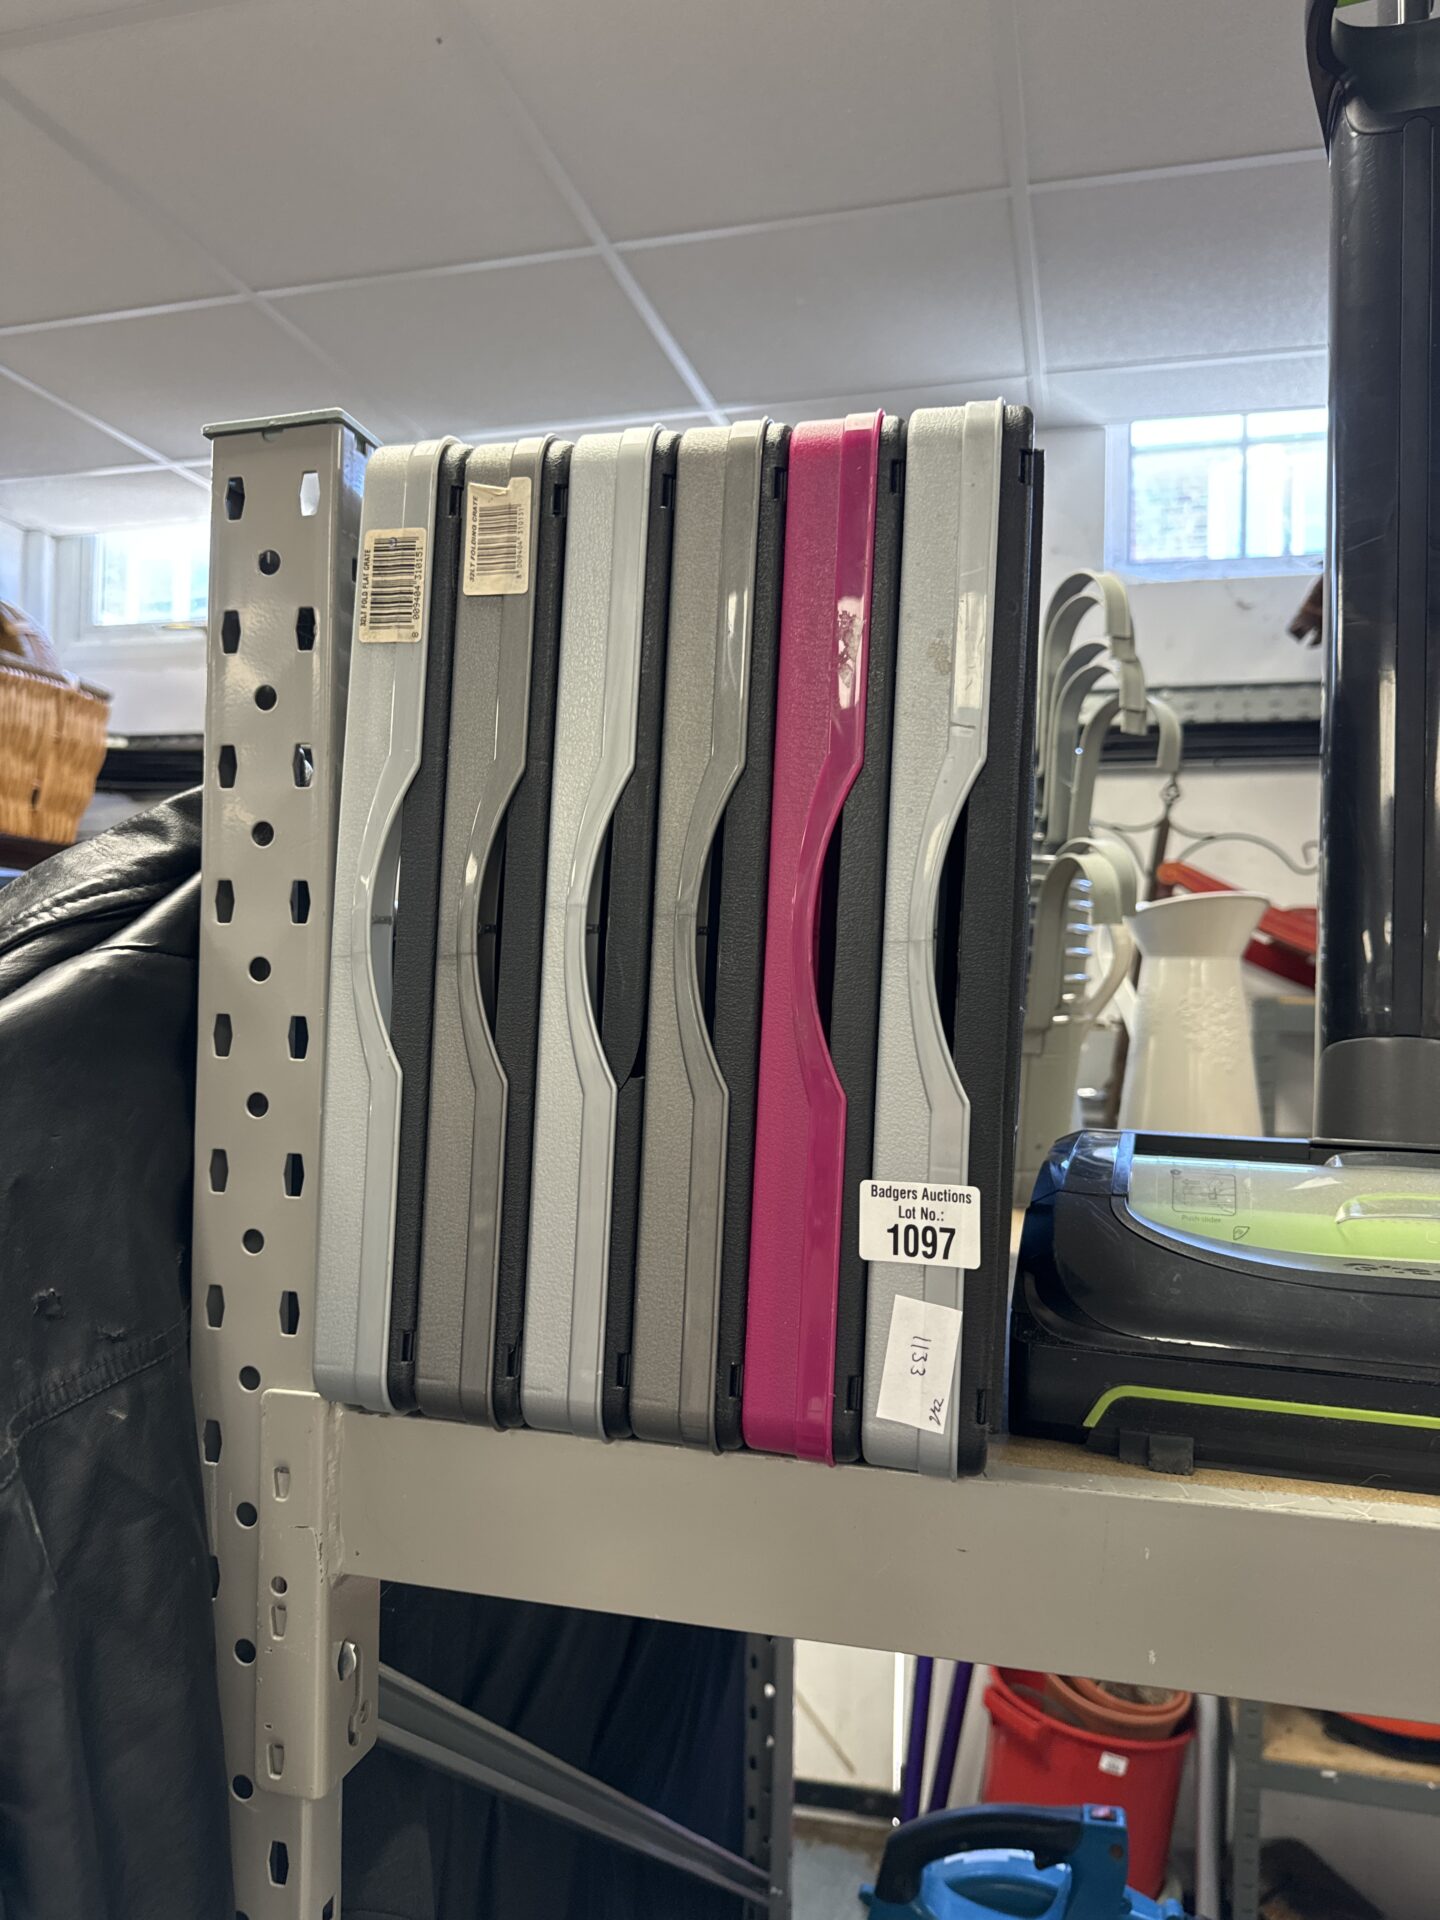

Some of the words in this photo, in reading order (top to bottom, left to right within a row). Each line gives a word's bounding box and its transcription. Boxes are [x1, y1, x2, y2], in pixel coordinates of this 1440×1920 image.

[415, 547, 423, 580] 310151
[413, 585, 421, 620] 009404
[871, 1184, 918, 1201] Badgers
[922, 1187, 972, 1204] Auctions
[898, 1205, 916, 1219] Lot
[920, 1207, 944, 1222] No.:
[887, 1223, 956, 1260] 1097
[910, 1335, 932, 1376] 1133
